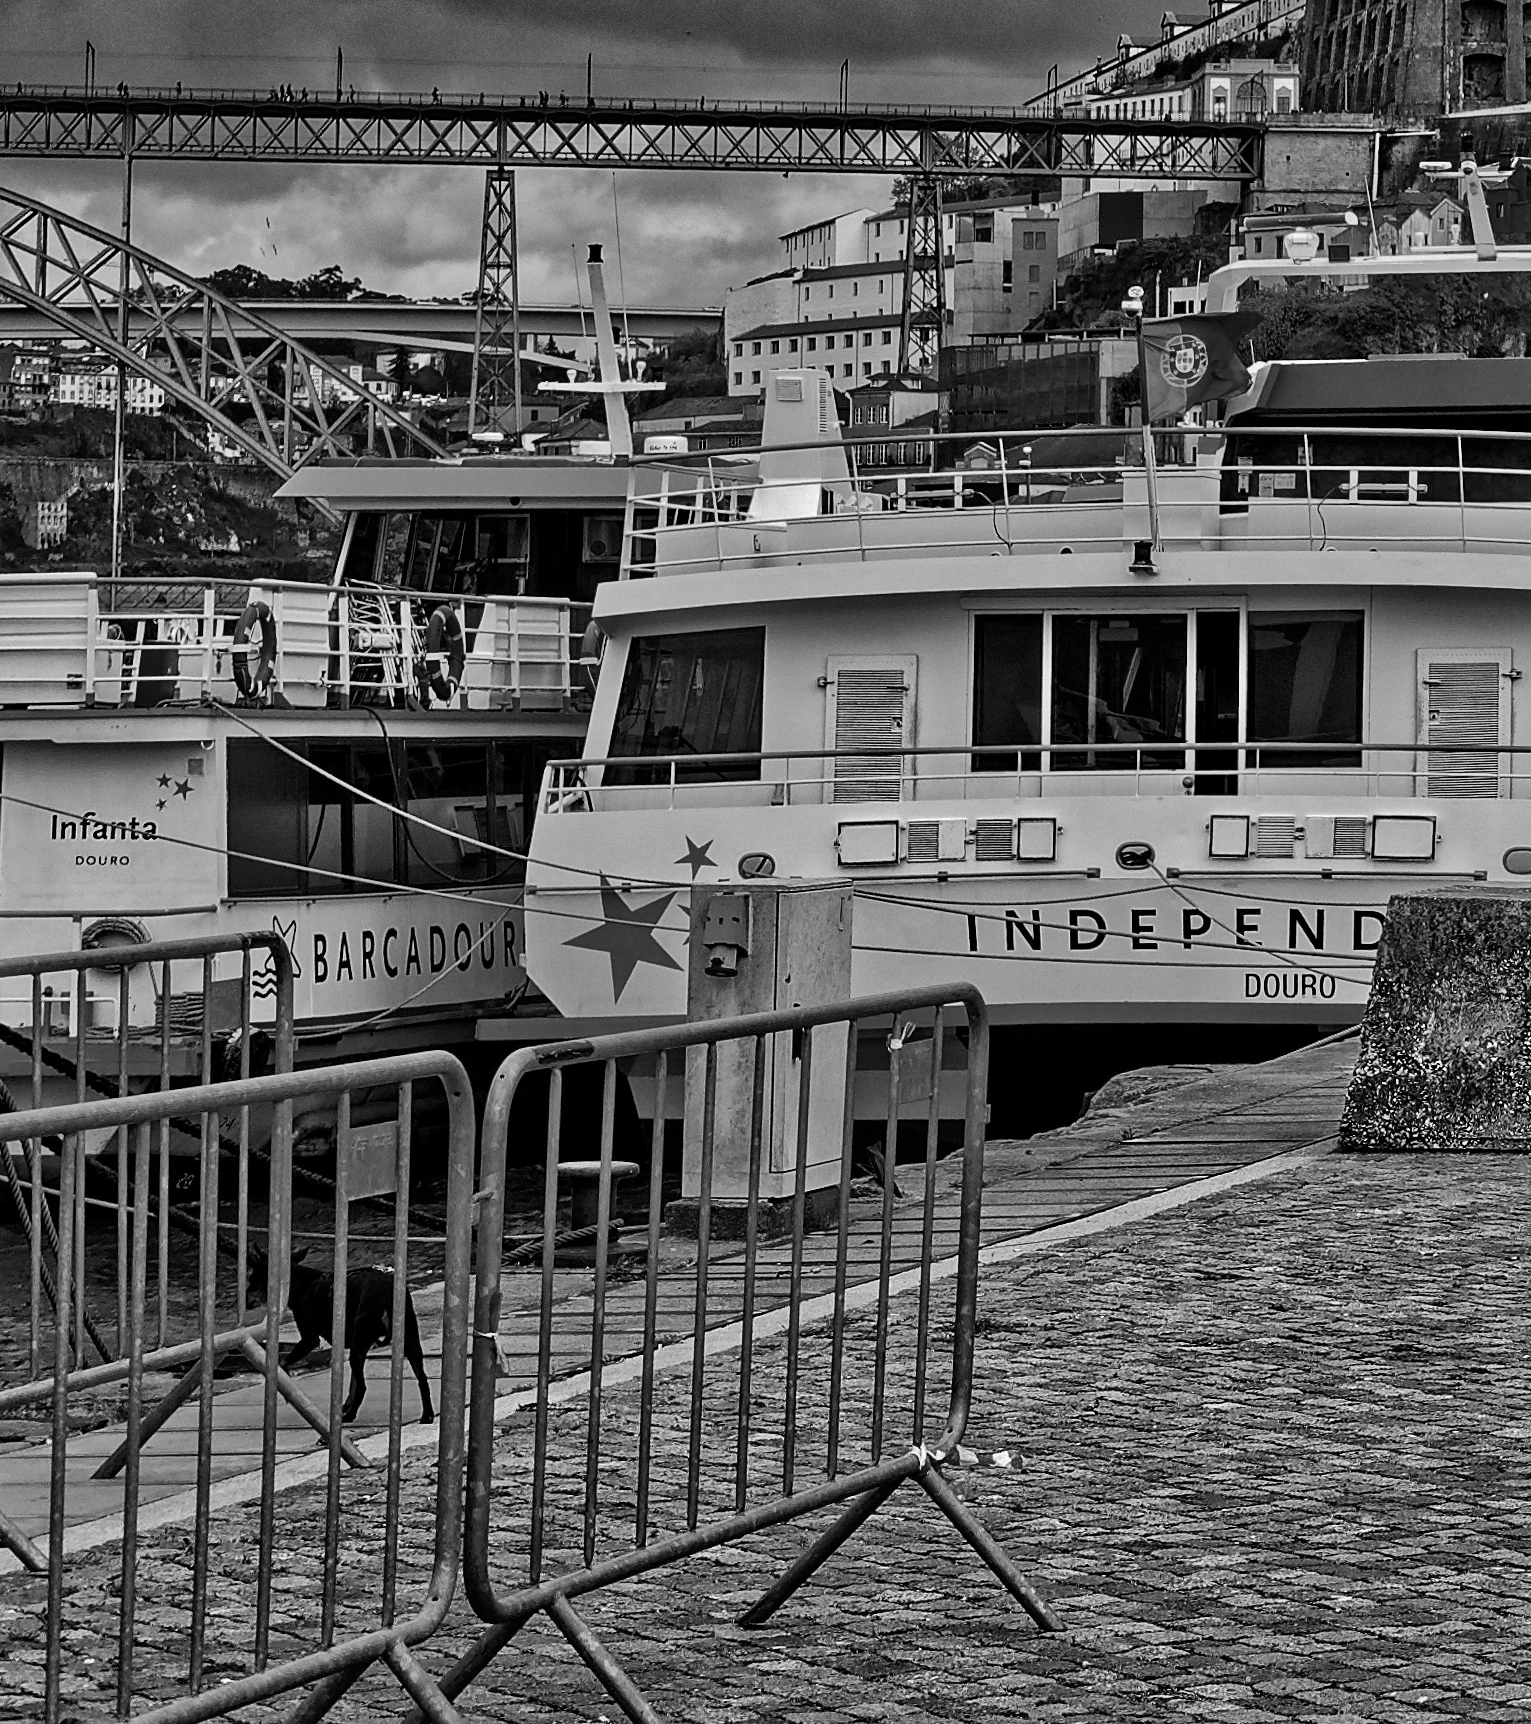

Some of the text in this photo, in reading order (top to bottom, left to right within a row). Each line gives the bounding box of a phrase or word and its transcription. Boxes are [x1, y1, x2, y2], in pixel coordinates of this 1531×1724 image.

[51, 811, 157, 840] Infanta
[75, 856, 130, 866] DOURO
[314, 920, 526, 984] BARCADOUR
[1245, 973, 1336, 999] DOURO
